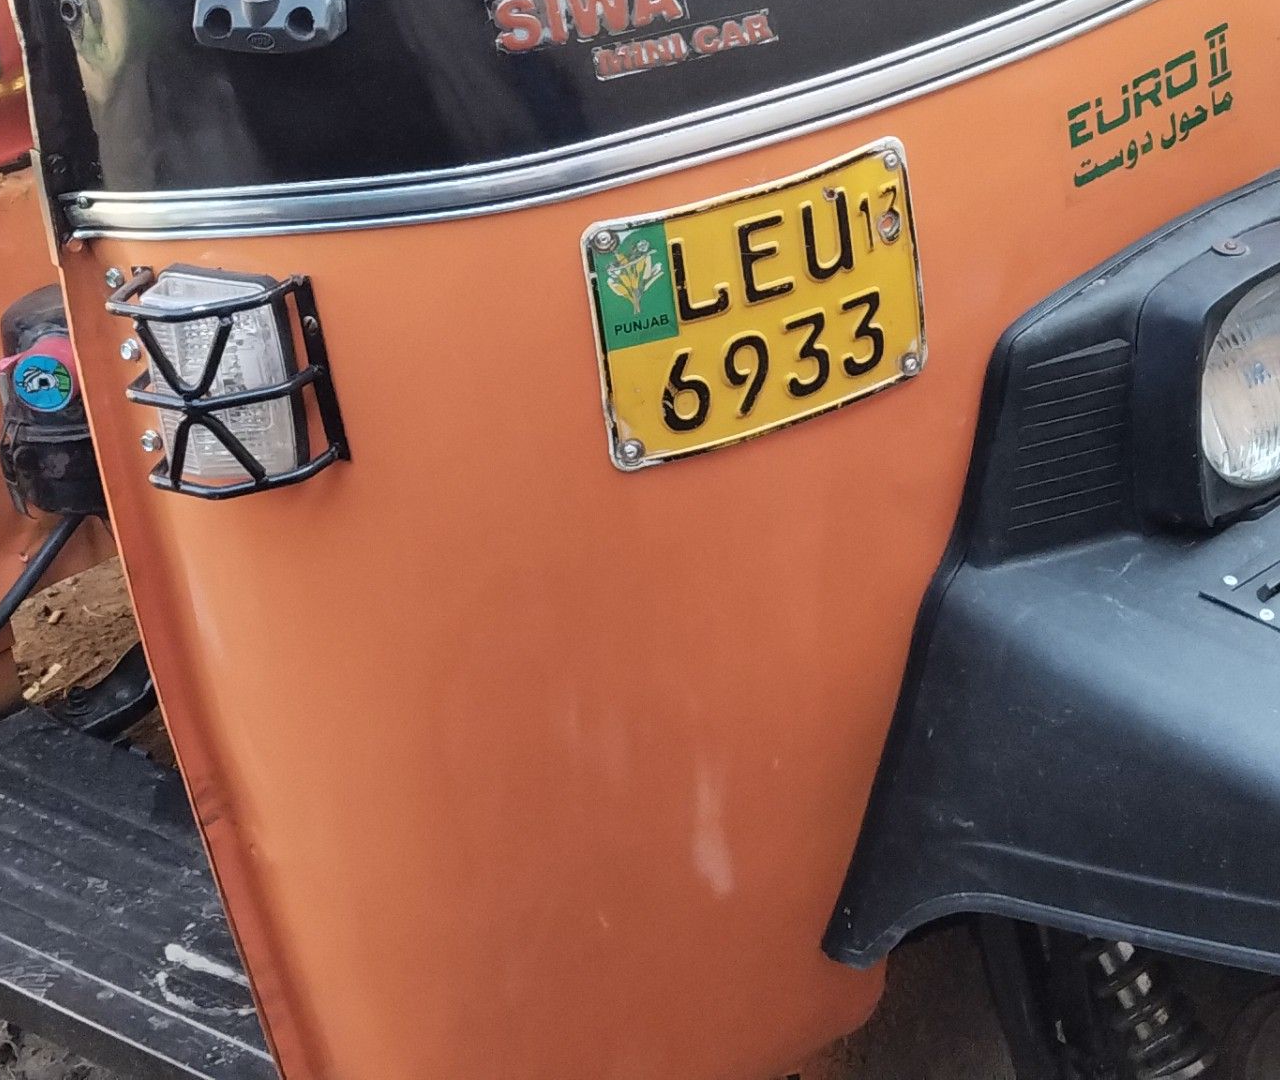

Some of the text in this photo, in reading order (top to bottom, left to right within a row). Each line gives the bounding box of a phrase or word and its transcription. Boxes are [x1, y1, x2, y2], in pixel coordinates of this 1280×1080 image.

[594, 14, 773, 77] MINI CAR
[1067, 49, 1198, 149] EURO
[1073, 130, 1154, 188] دوست
[670, 187, 856, 322] LEU
[614, 313, 670, 336] PUNJAB
[660, 286, 886, 433] 6933
